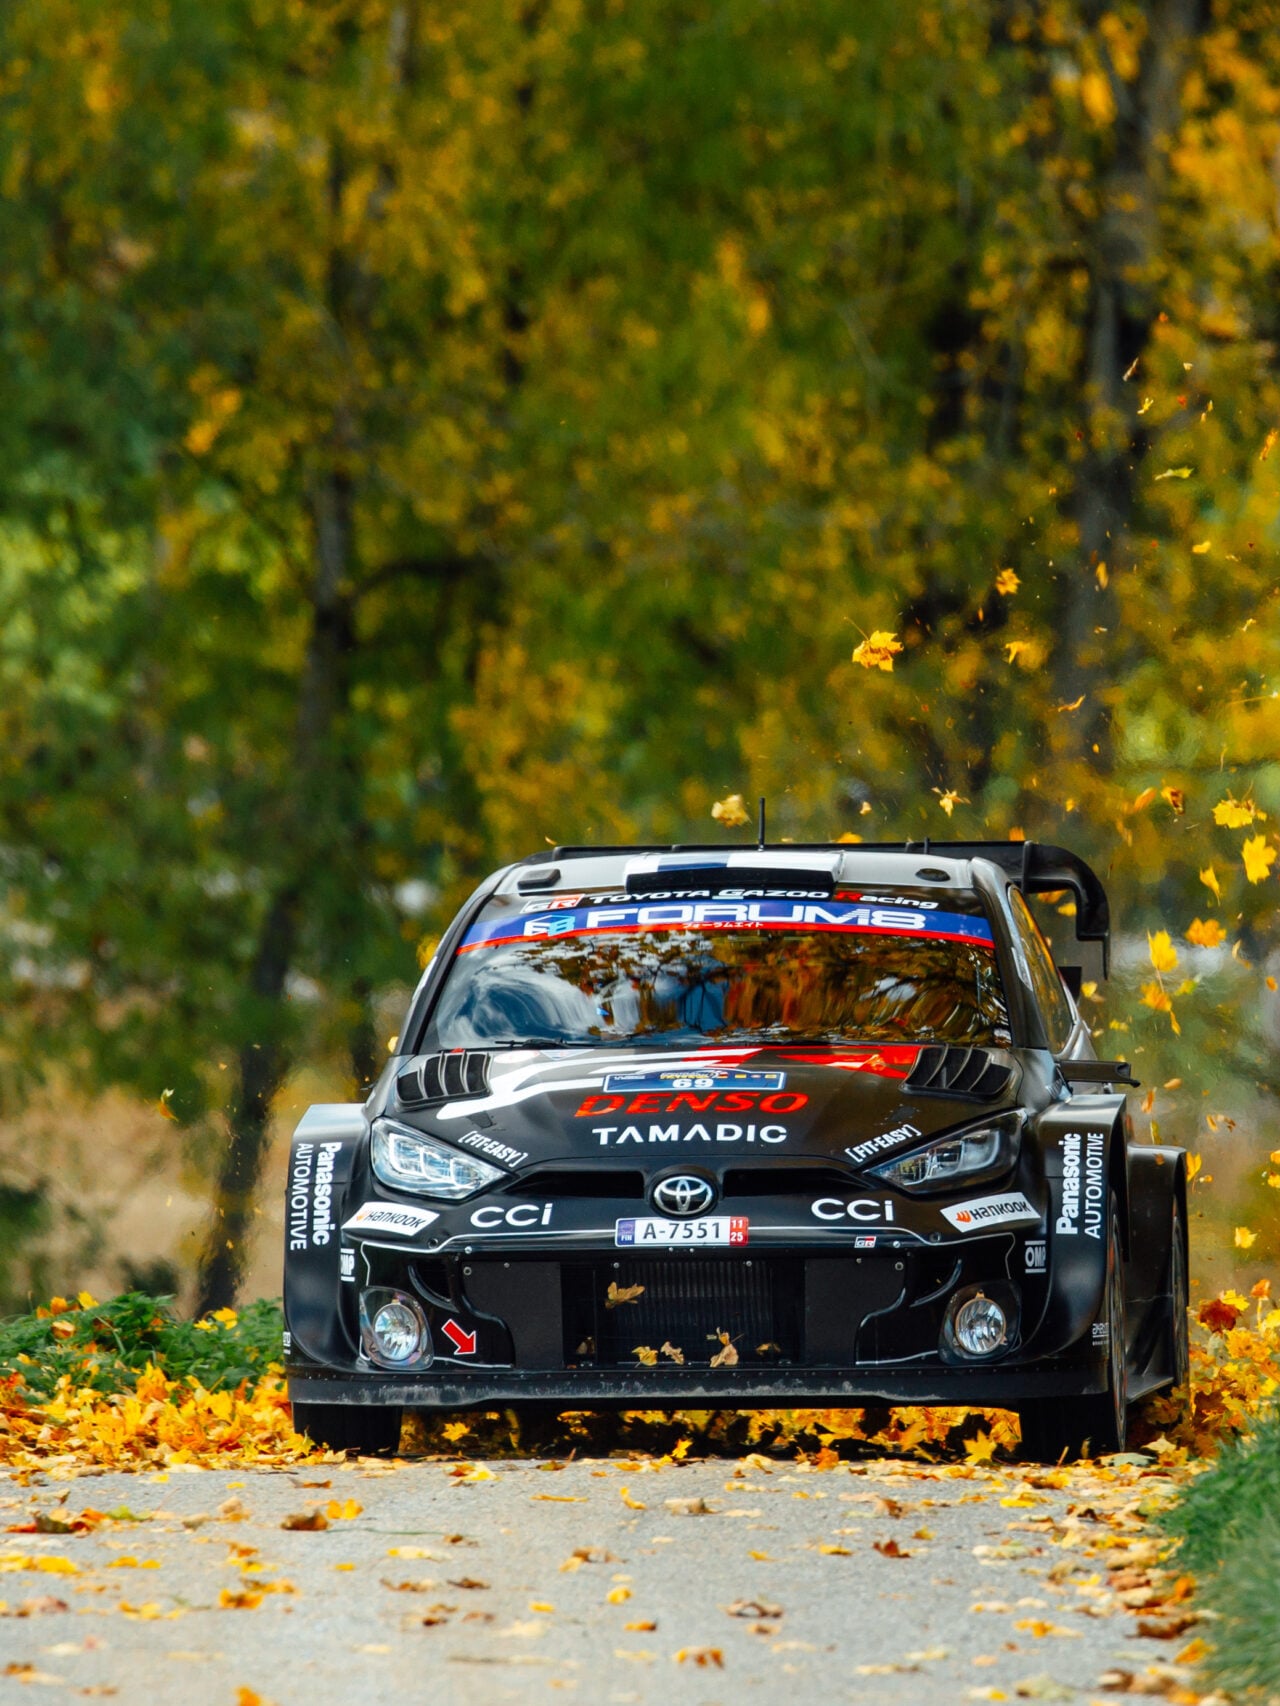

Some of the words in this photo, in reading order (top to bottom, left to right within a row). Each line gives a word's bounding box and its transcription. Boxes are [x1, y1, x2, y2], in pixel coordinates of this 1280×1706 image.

[590, 890, 709, 904] TOYOTA
[712, 888, 829, 900] GAZOO
[833, 891, 939, 909] Racing
[586, 904, 926, 930] FORUM8
[672, 1078, 714, 1088] 69
[574, 1092, 809, 1117] DENSO
[592, 1124, 787, 1146] TAMADIC
[312, 1141, 343, 1246] Panasonic
[1055, 1132, 1082, 1235] Panasonic
[1084, 1132, 1104, 1239] AUTOMOTIVE
[290, 1142, 314, 1251] AUTOMOTIVE
[643, 1222, 720, 1239] A-7551
[731, 1219, 744, 1229] 11
[730, 1231, 744, 1242] 25
